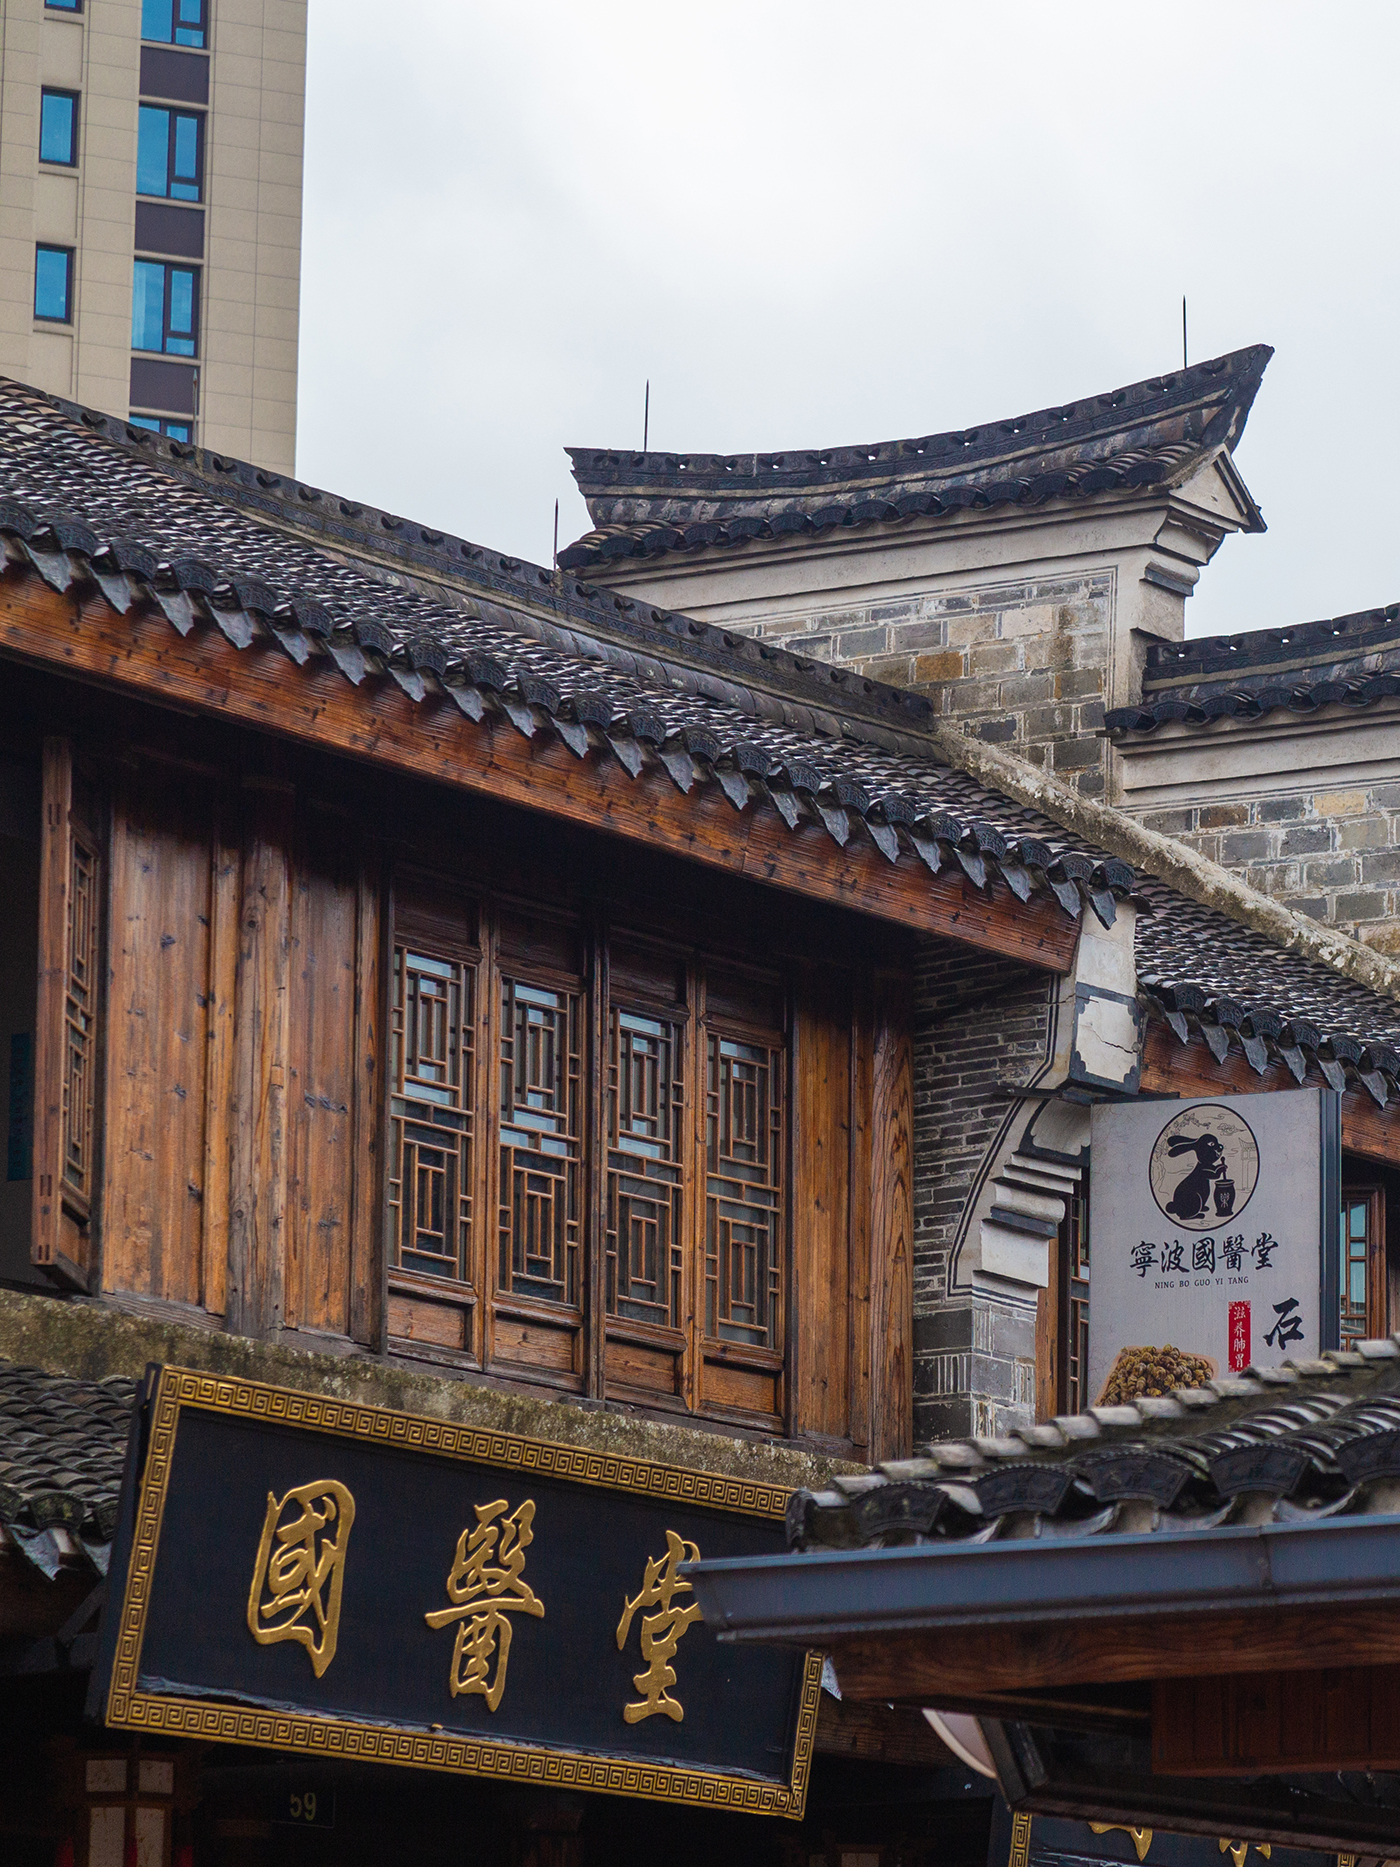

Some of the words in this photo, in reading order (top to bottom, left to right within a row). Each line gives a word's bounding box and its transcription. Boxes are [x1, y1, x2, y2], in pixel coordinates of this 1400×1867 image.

[1130, 1232, 1279, 1278] 寧波國醫堂
[1154, 1280, 1175, 1289] NING
[1179, 1280, 1190, 1288] BO
[1194, 1278, 1211, 1287] GUO
[1215, 1278, 1223, 1286] YI
[1228, 1276, 1249, 1285] TANG
[1233, 1306, 1246, 1368] 滋养肺胃
[247, 1478, 705, 1725] 國醫堂
[289, 1792, 317, 1821] 59
